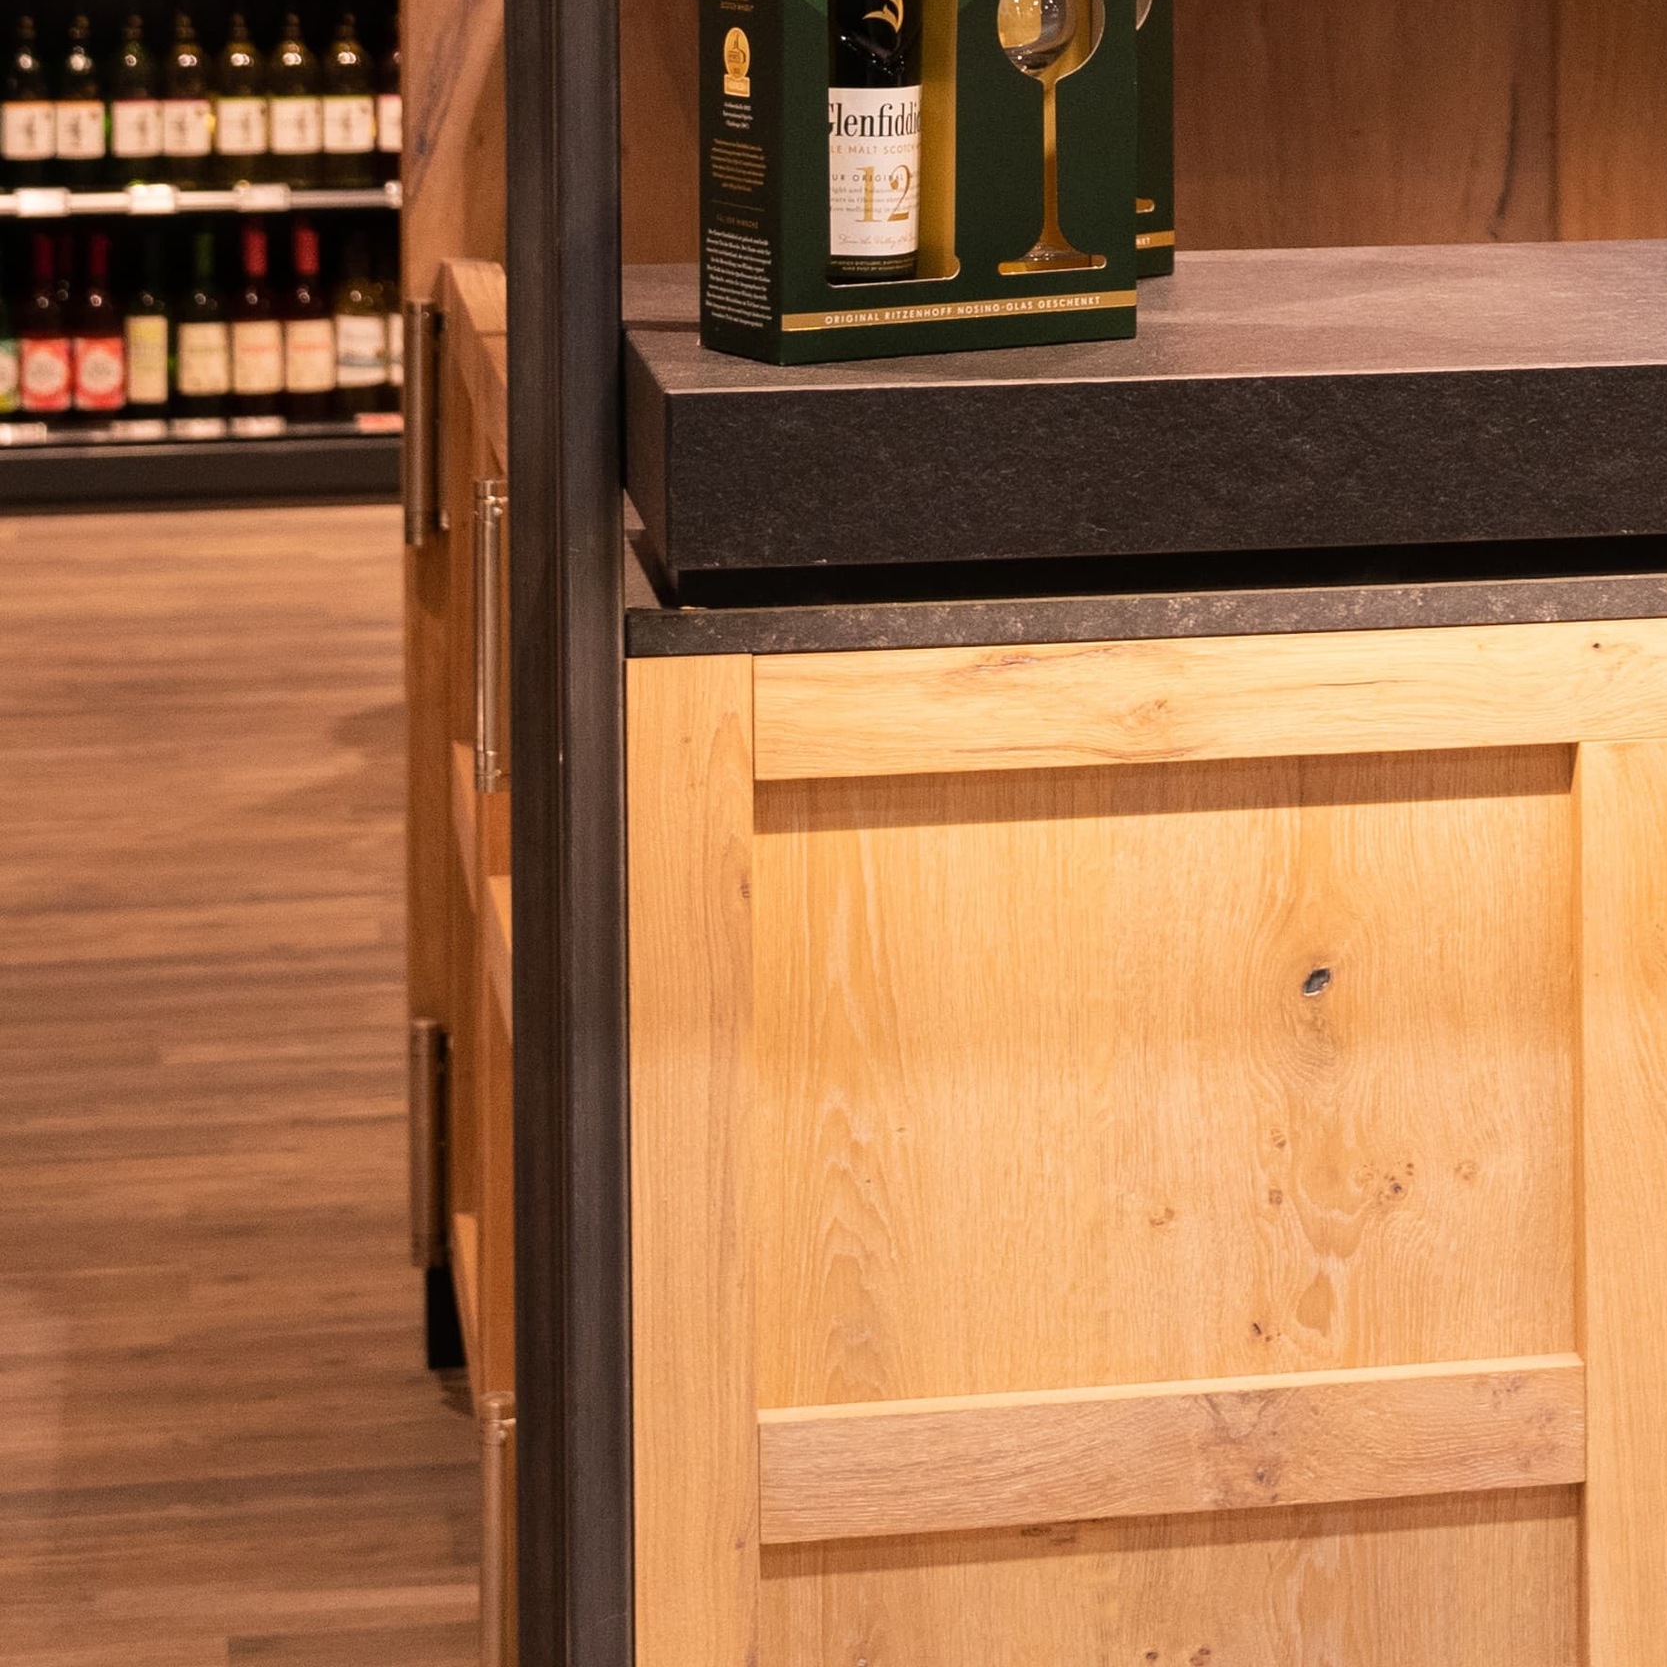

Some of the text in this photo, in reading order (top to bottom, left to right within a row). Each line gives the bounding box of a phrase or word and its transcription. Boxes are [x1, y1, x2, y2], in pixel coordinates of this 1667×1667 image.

[848, 145, 878, 155] MALT
[854, 164, 911, 223] 12
[824, 294, 1101, 326] ORIGINAL RITZENHOFF NOSING-GLAS GESCHENKT
